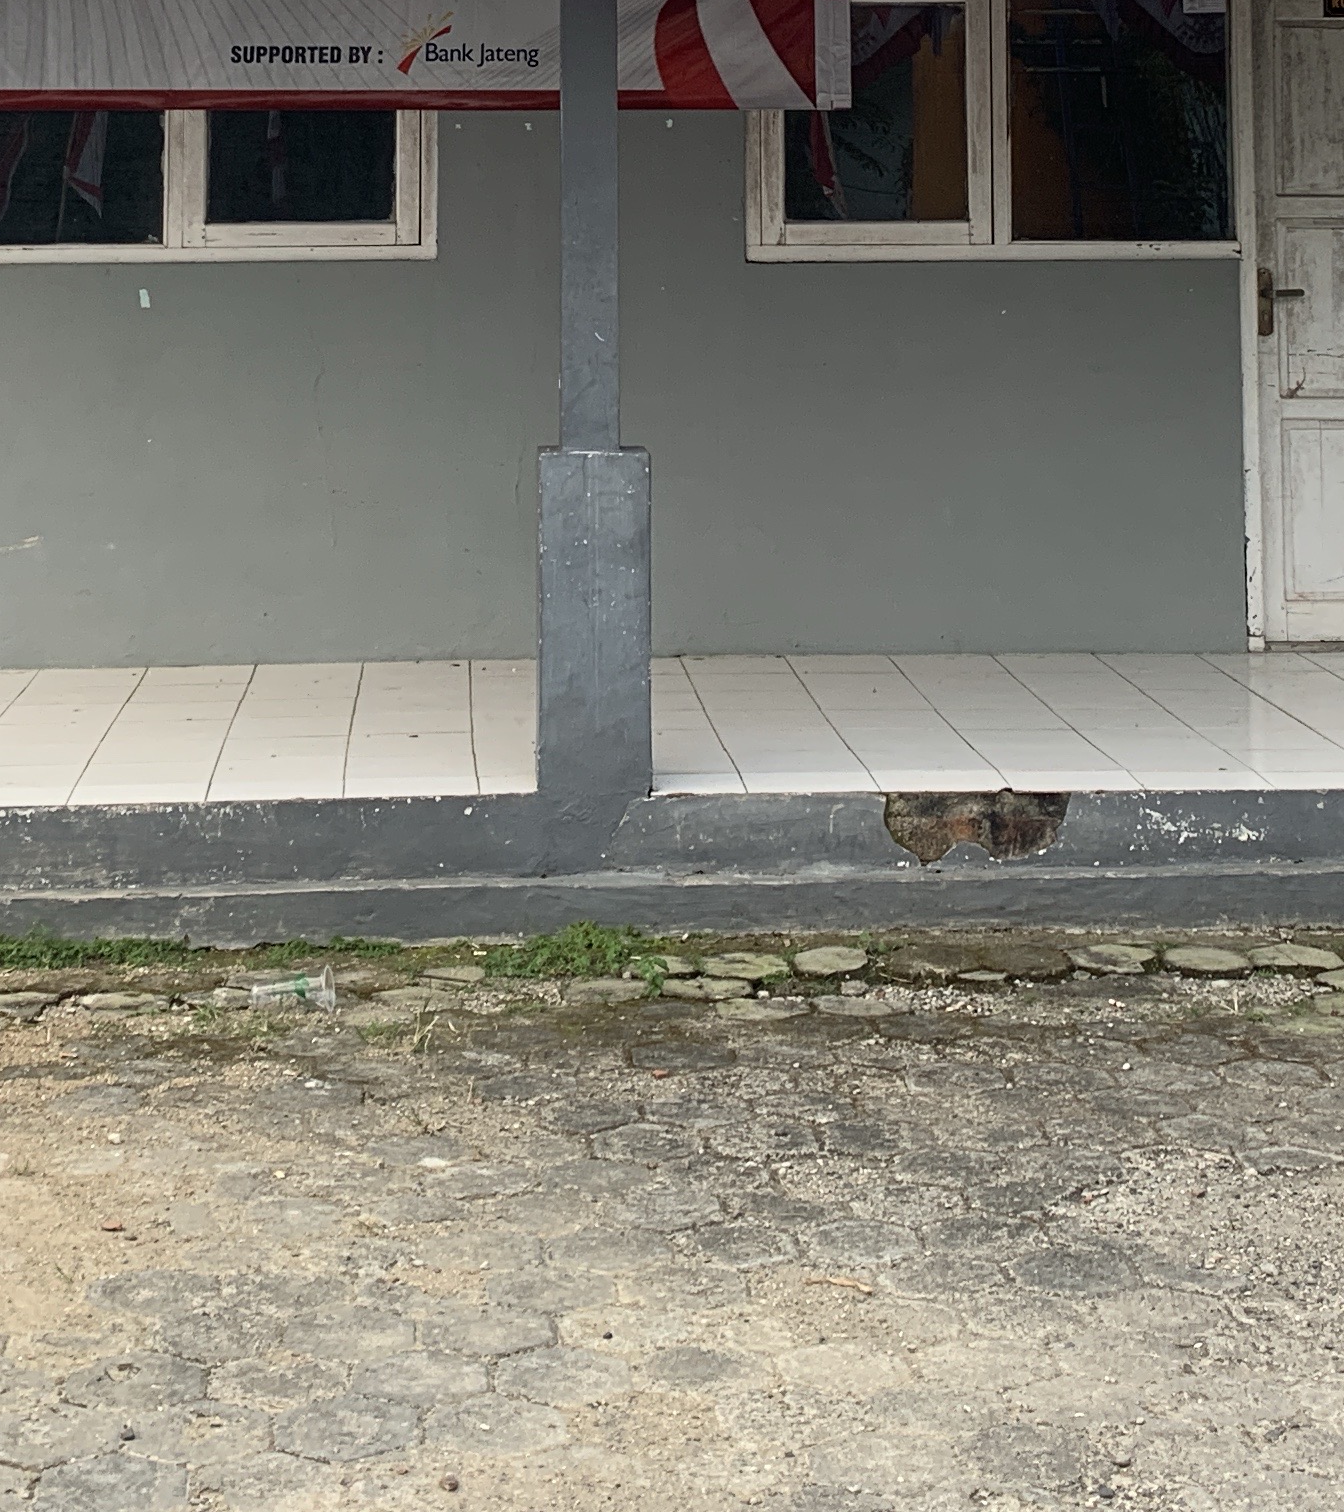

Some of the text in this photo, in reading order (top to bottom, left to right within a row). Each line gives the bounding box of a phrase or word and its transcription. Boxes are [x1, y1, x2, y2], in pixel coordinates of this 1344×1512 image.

[230, 45, 342, 64] SUPPORTED
[348, 45, 372, 64] BY
[425, 43, 540, 68] Bank Jateng
